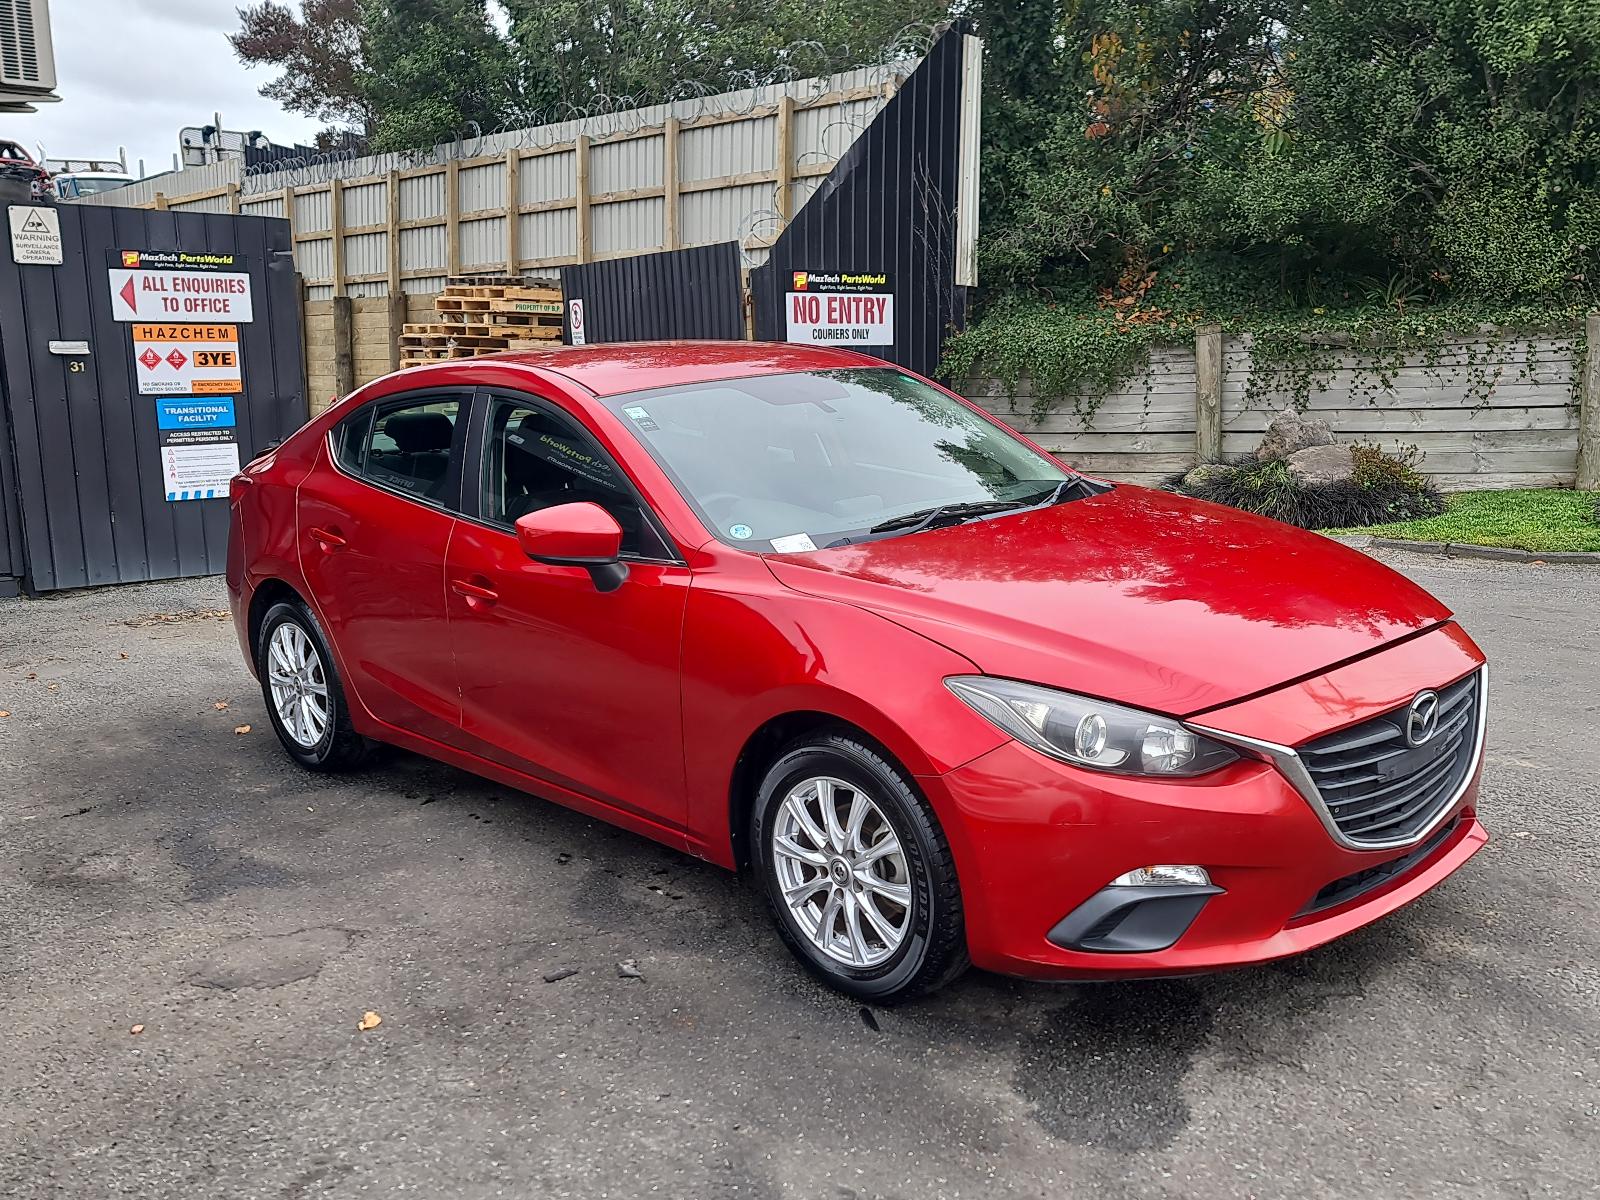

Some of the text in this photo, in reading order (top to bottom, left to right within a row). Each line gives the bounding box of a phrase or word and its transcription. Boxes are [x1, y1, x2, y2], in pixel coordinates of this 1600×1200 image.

[14, 233, 59, 242] WARNING
[140, 253, 232, 264] MazTech PartsWorld
[808, 274, 886, 284] MazTech PartsWorld
[142, 276, 245, 294] ALL ENQUIRIES
[162, 297, 230, 313] TO OFFICE
[793, 296, 886, 324] NO ENTRY
[143, 328, 228, 339] HAZCHEM
[813, 329, 870, 339] COURIERS ONLY
[198, 352, 232, 365] 3YE
[70, 361, 85, 372] 31
[164, 406, 229, 414] TRANSITIONAL
